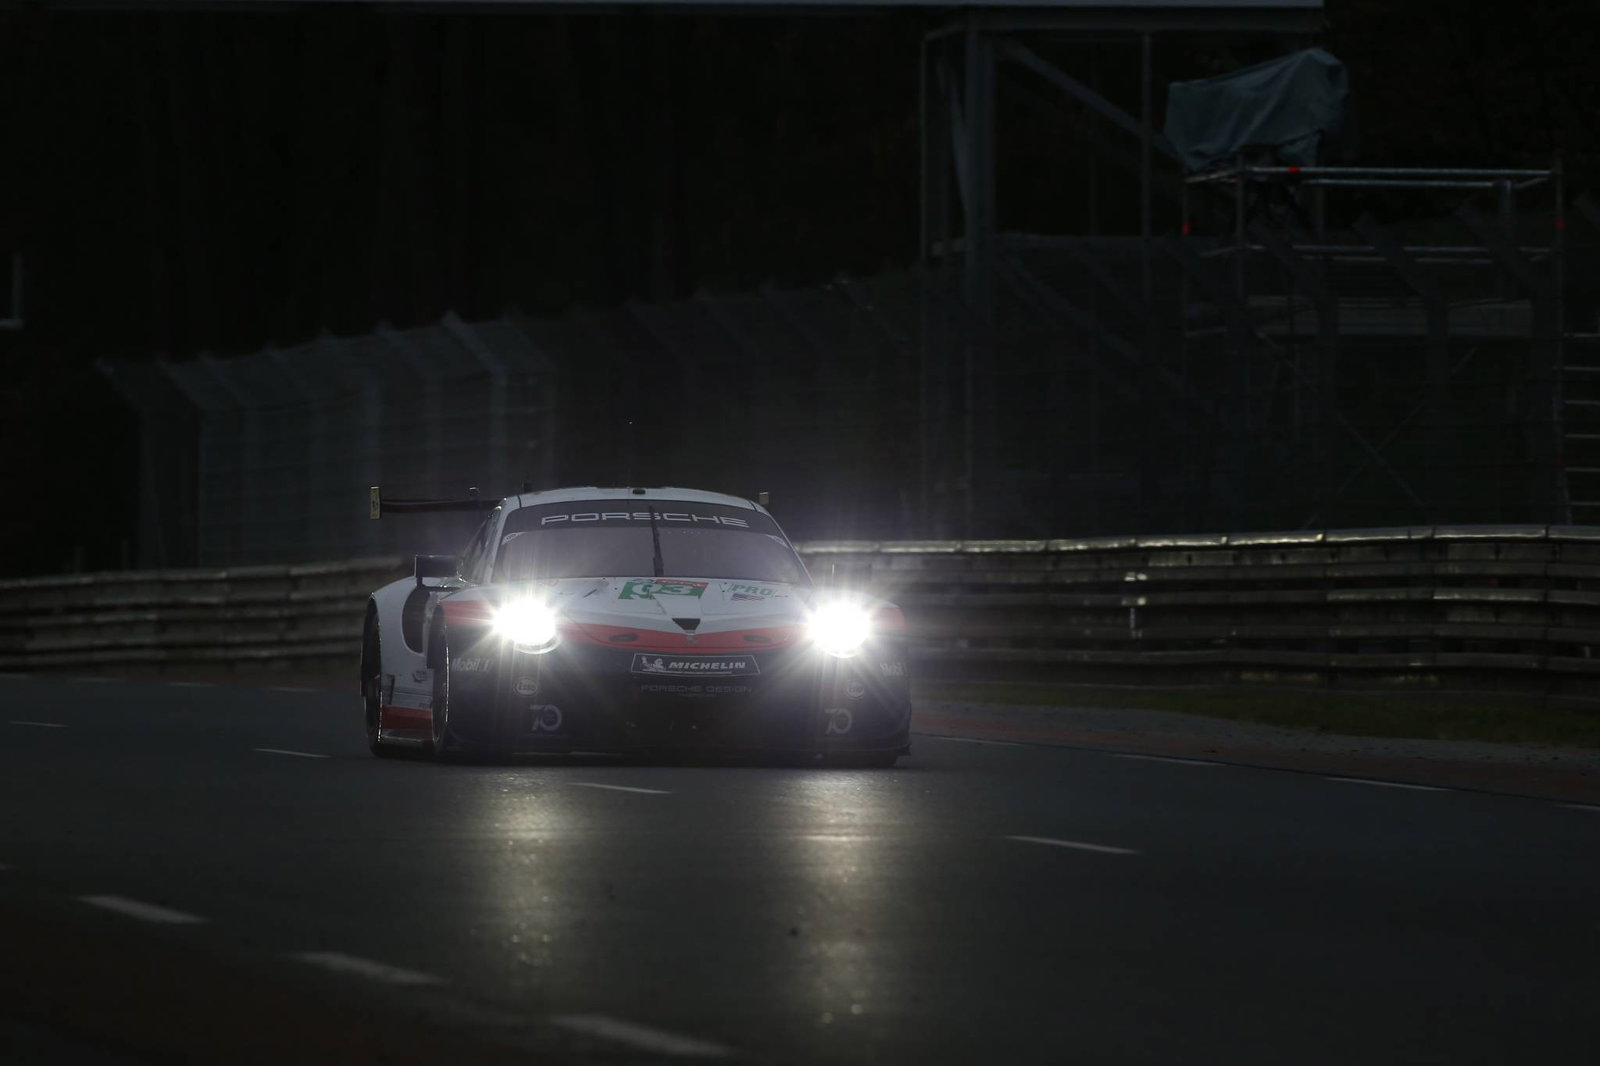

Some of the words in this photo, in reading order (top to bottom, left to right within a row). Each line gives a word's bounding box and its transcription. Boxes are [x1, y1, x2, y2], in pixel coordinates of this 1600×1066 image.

[541, 512, 750, 528] PORSCHE
[731, 584, 774, 596] PRO
[451, 657, 481, 672] Mobil
[668, 661, 746, 670] MICHELIN
[640, 684, 703, 694] PORSCHE
